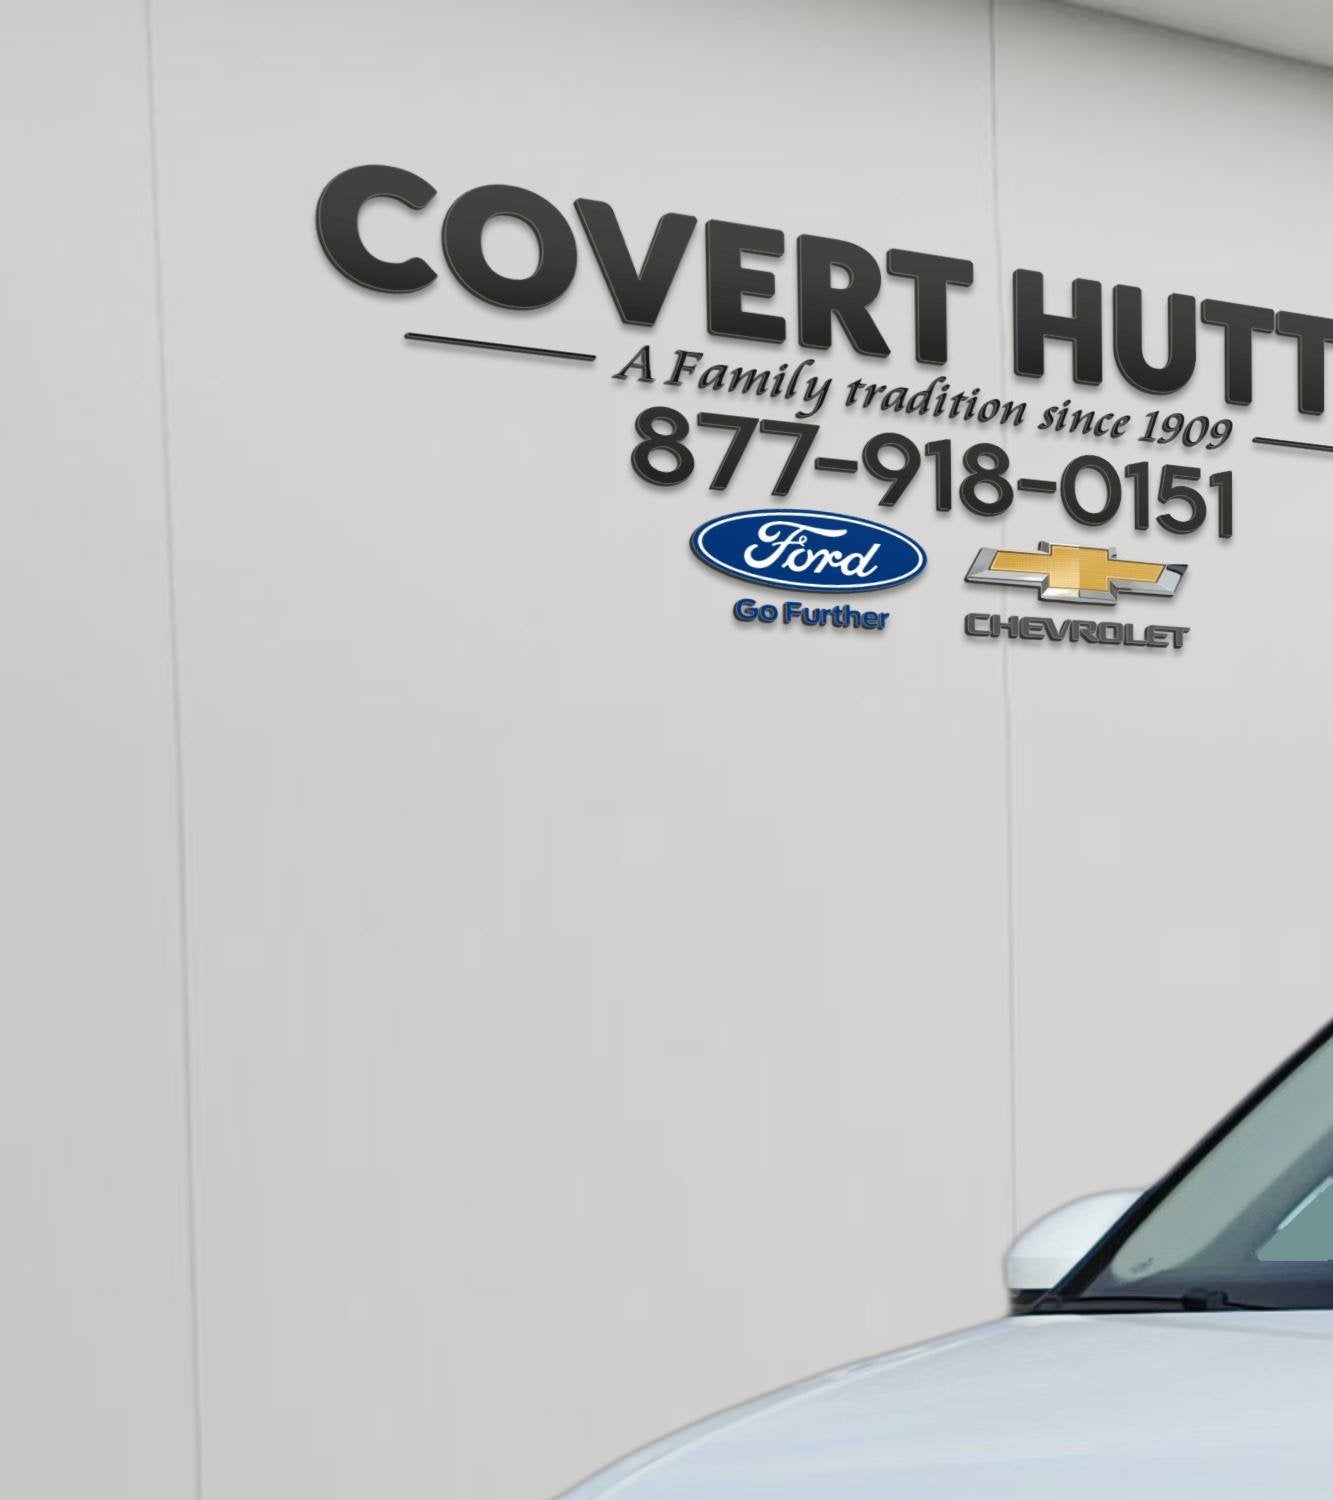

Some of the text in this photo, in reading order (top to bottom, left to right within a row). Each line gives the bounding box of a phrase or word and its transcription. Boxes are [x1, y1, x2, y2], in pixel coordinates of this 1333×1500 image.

[315, 164, 975, 368] COVERT
[612, 344, 1234, 451] A Family tradition since 1909
[630, 406, 1234, 540] 877-918-0151
[743, 519, 880, 579] Ford
[732, 597, 890, 631] Go Further
[964, 612, 1190, 650] CHEVROLET
